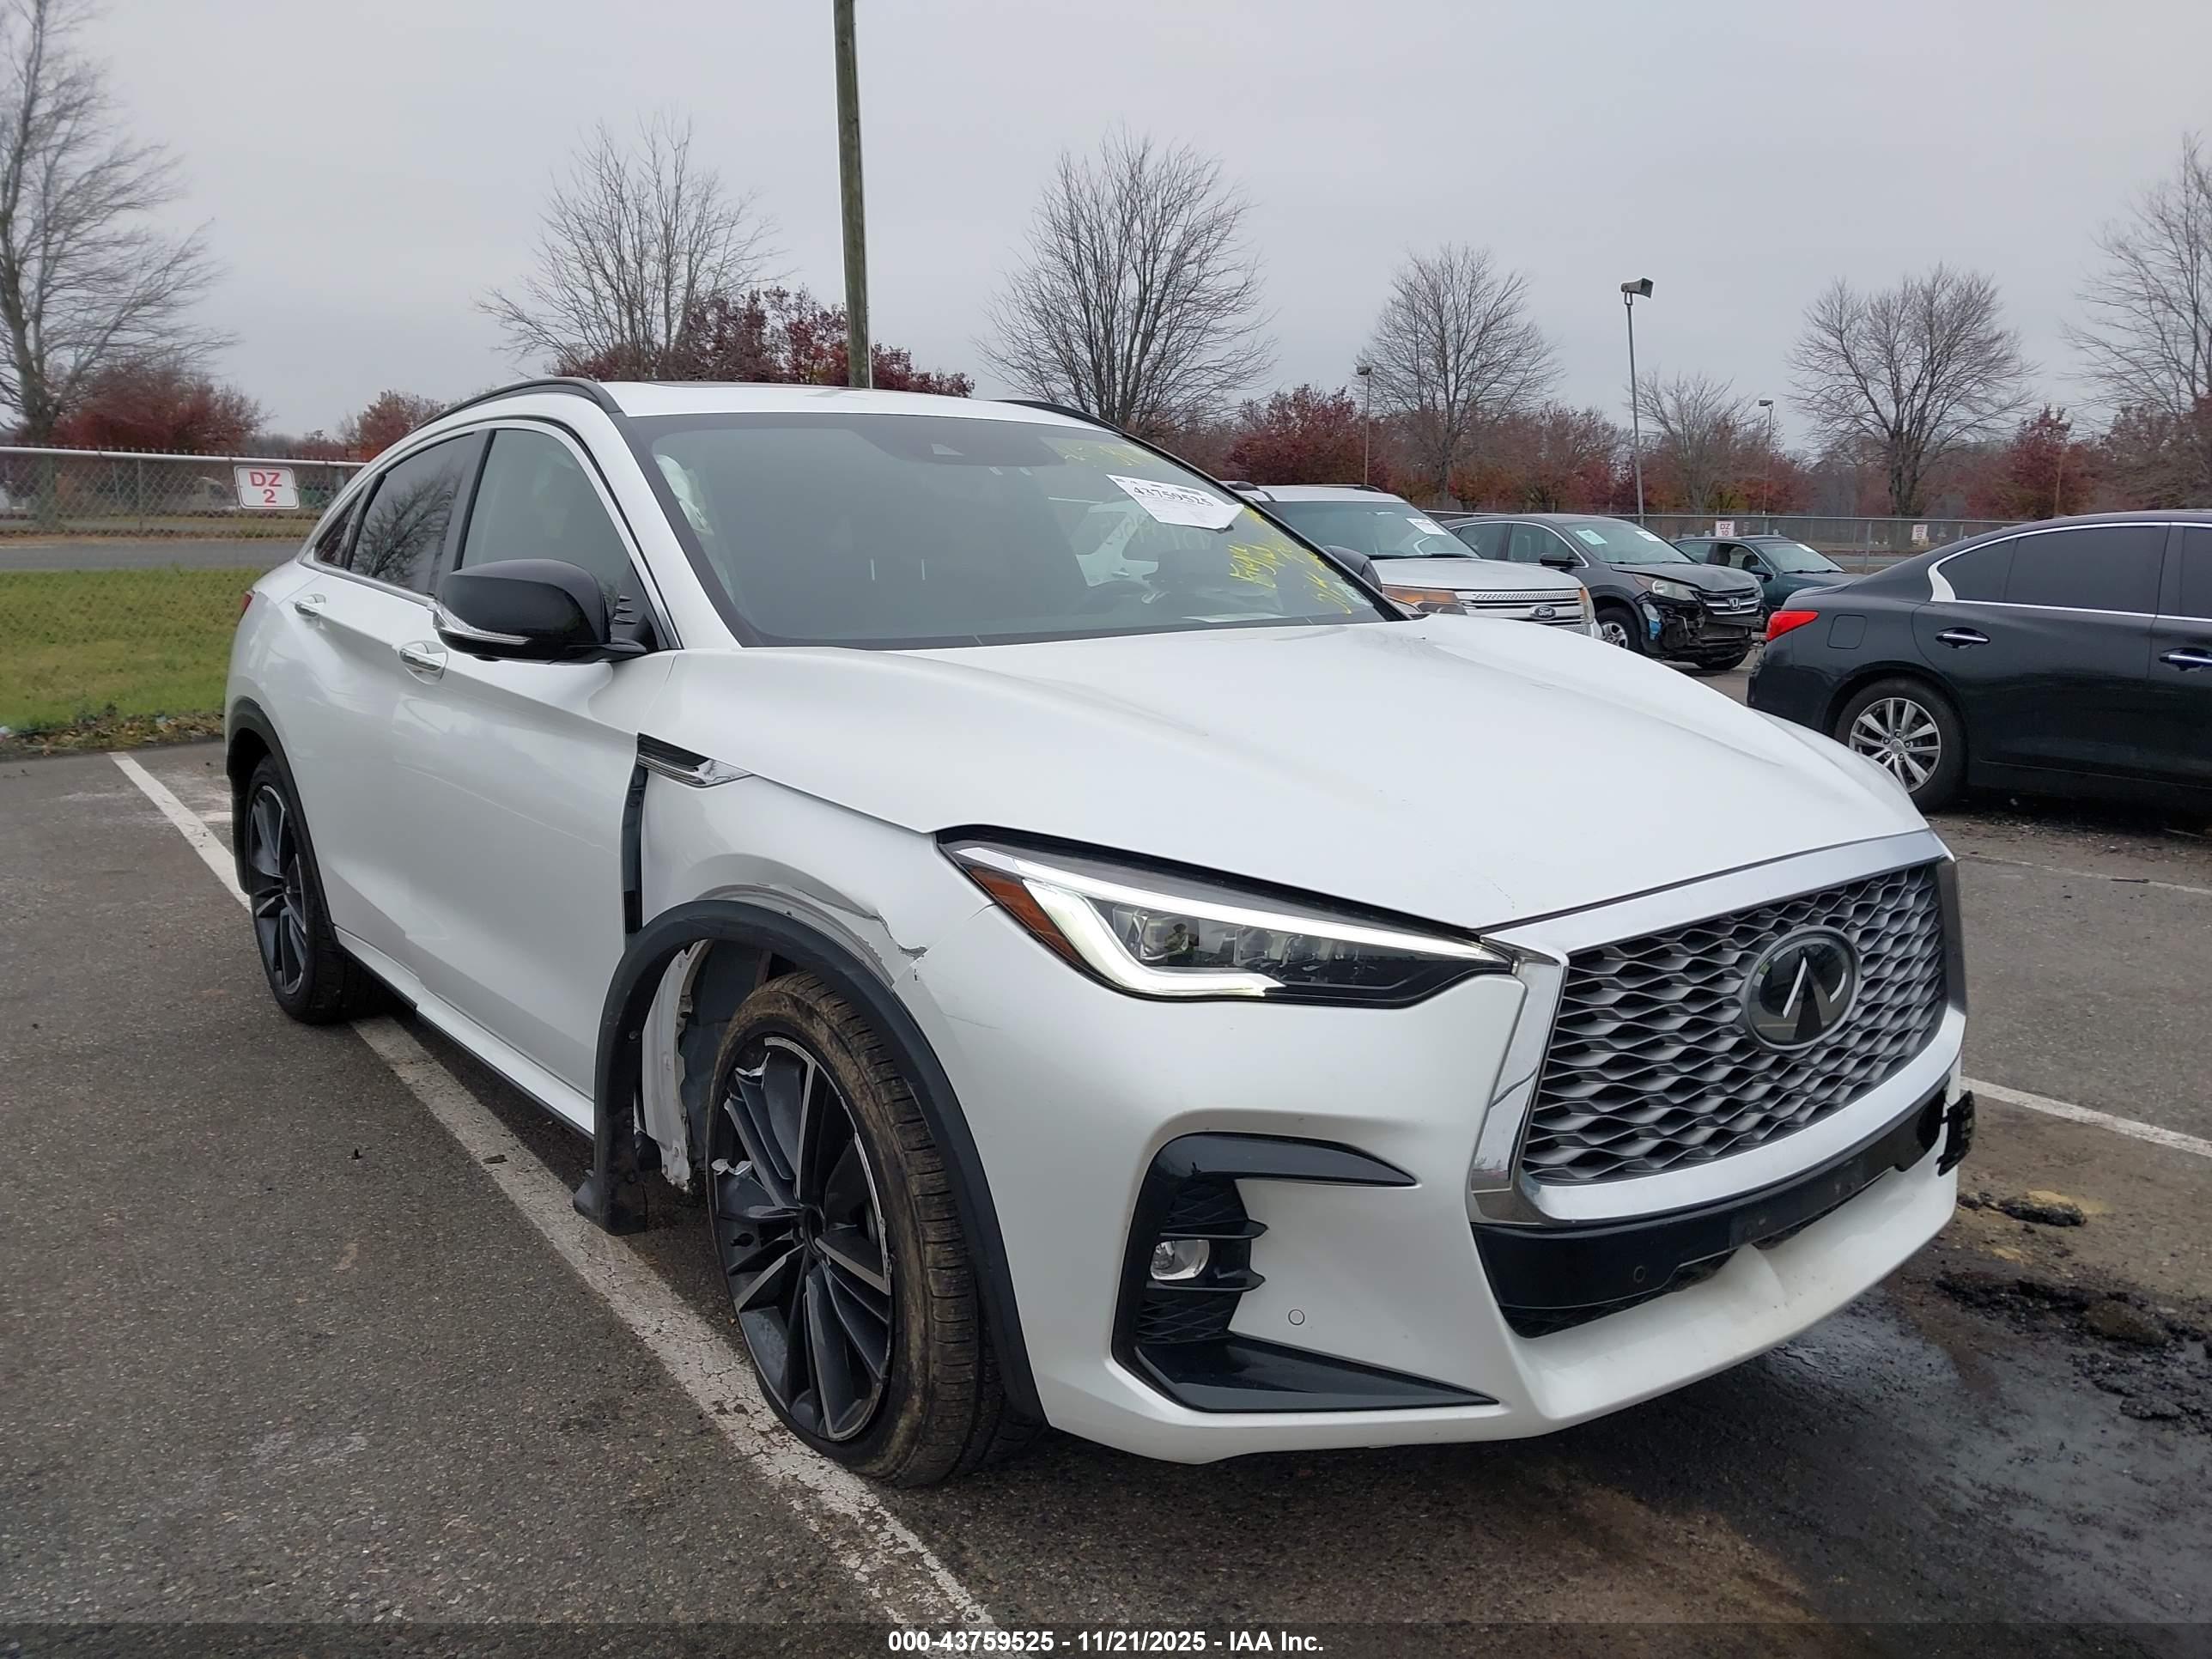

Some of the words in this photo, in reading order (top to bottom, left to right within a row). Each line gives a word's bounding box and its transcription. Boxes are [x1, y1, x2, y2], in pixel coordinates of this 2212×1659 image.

[249, 471, 283, 487] DZ
[263, 489, 276, 503] 2
[1133, 486, 1214, 507] 43759525
